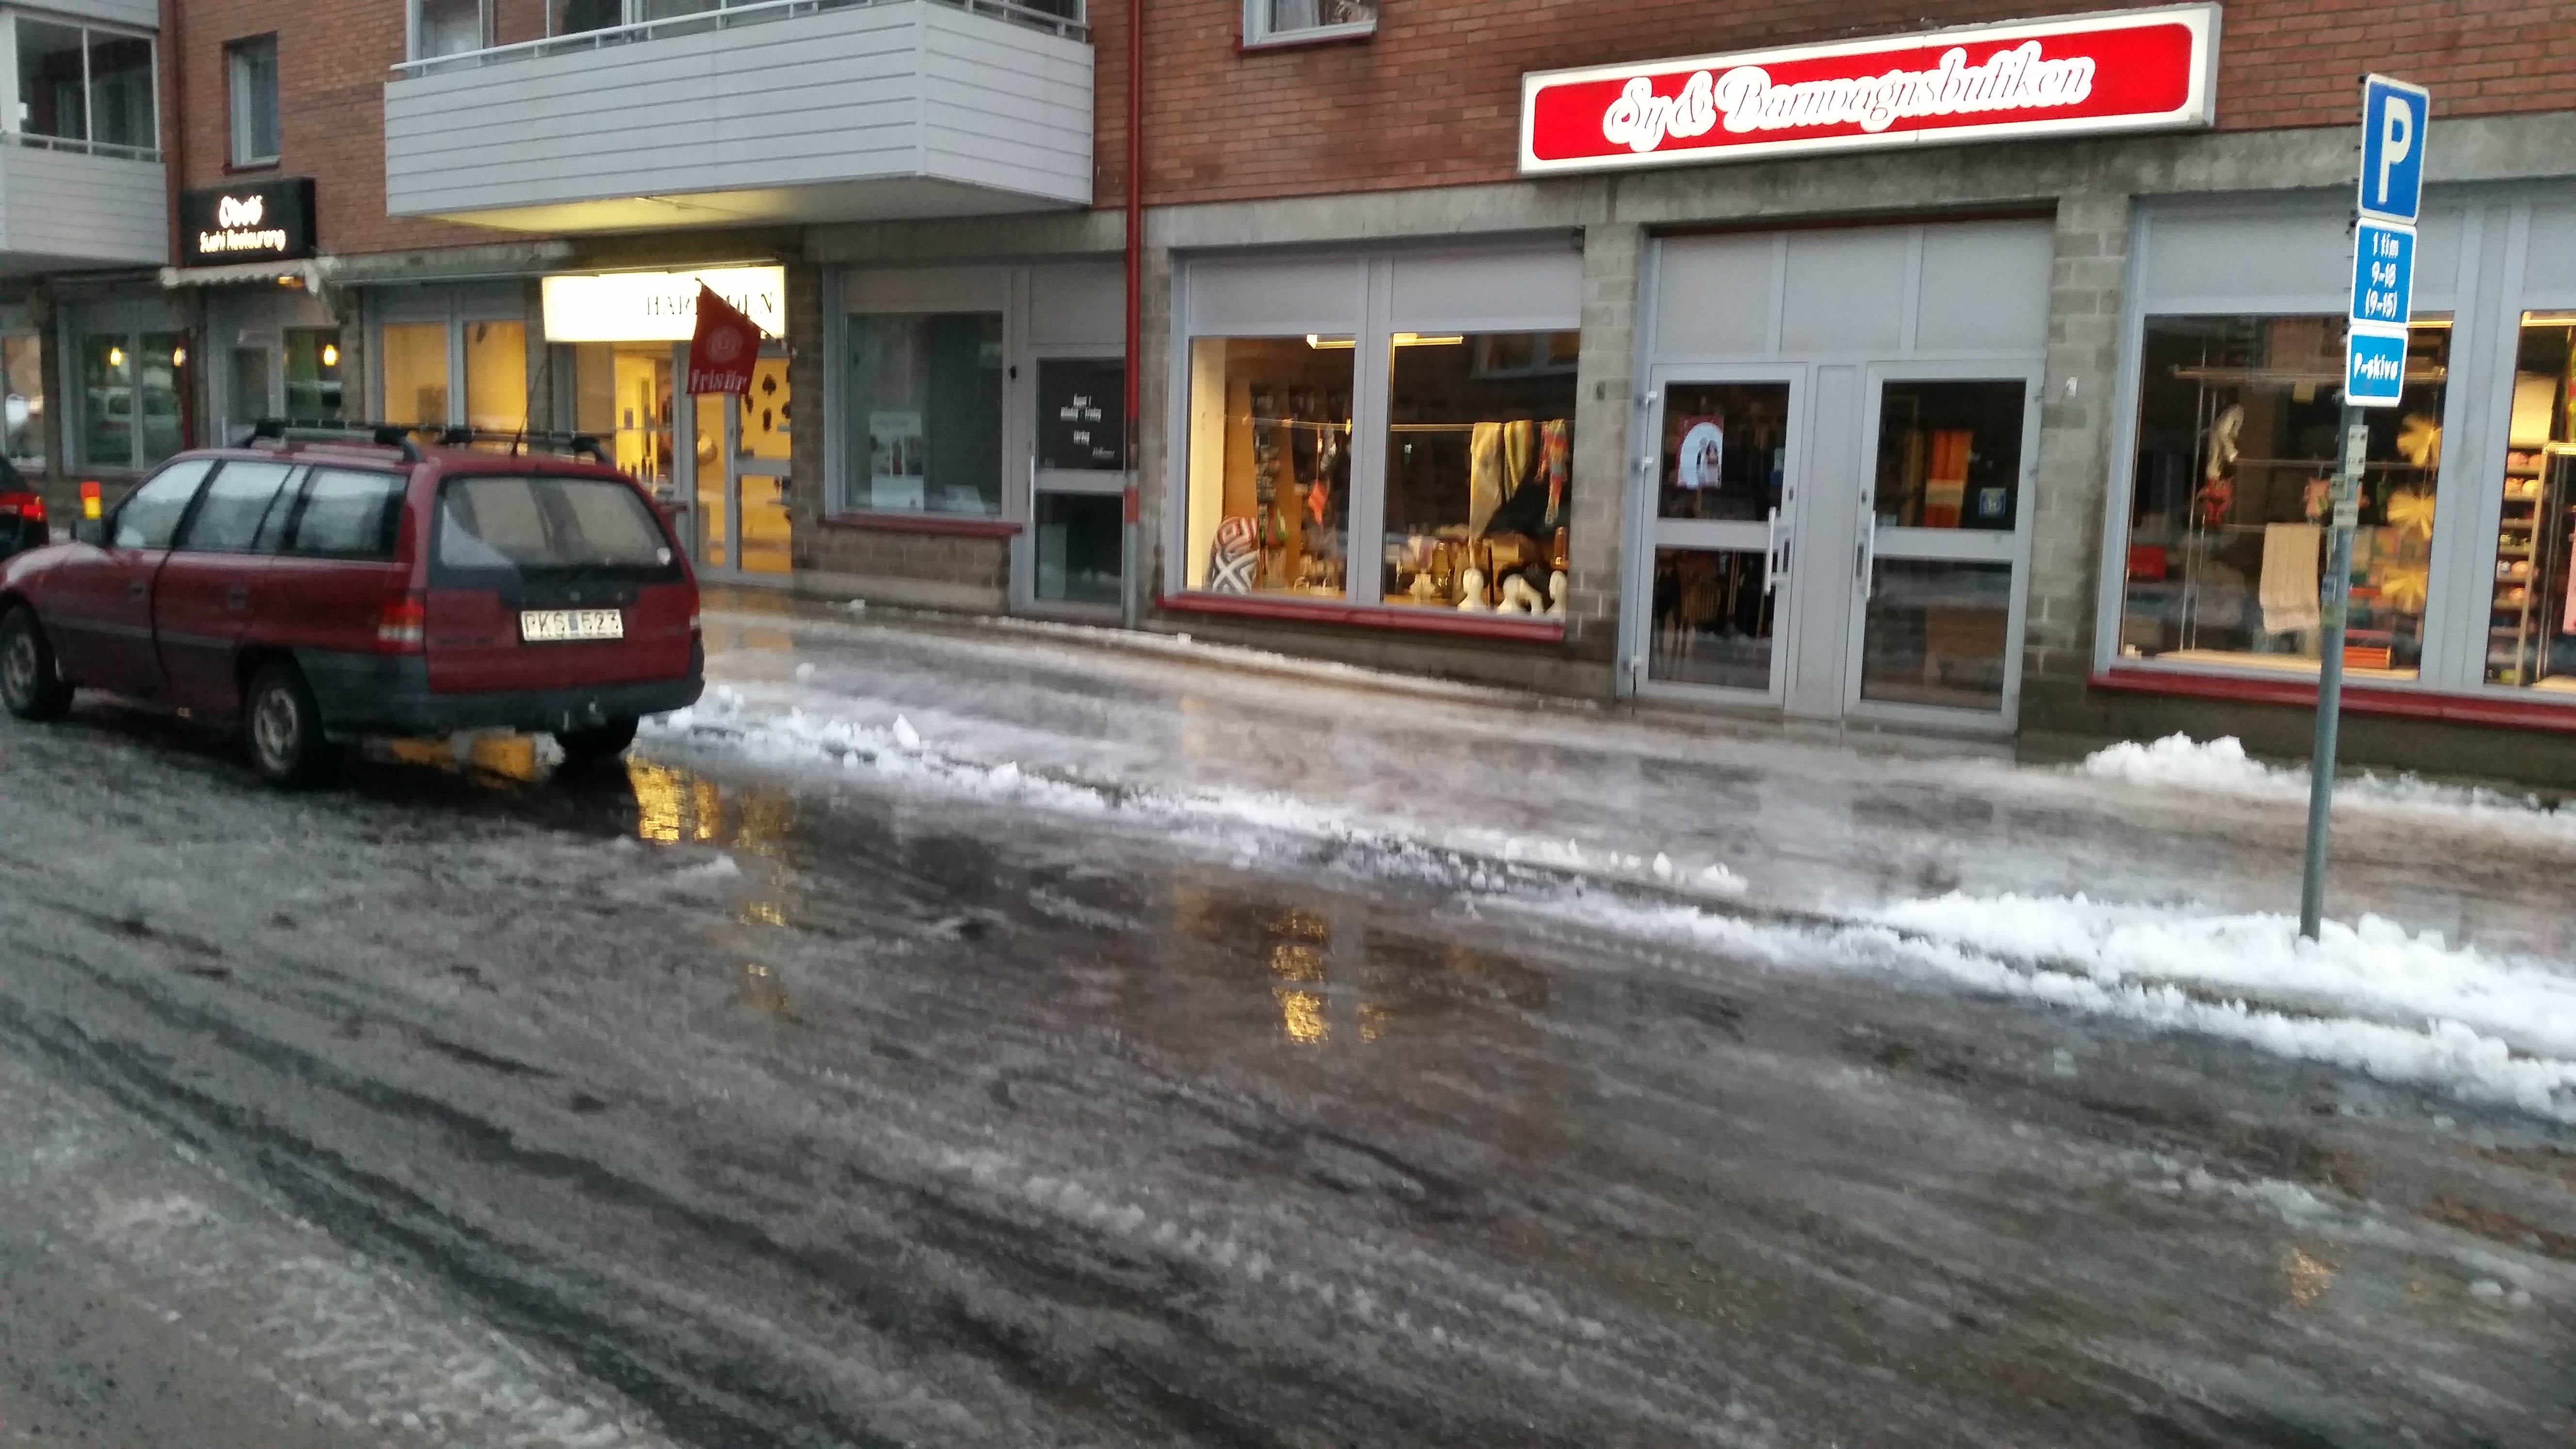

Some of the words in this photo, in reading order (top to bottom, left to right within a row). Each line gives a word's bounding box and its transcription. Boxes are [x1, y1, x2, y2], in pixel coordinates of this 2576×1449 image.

[1603, 77, 1672, 152] Sy
[1667, 70, 1717, 138] &
[1715, 40, 2095, 133] Barnvagnsbutiken
[2378, 96, 2413, 205] P
[2373, 231, 2379, 256] 1
[2381, 233, 2399, 258] tim
[2372, 260, 2397, 288] 9-18
[2365, 288, 2398, 320] (9-15)
[2354, 352, 2399, 381] P-skiva
